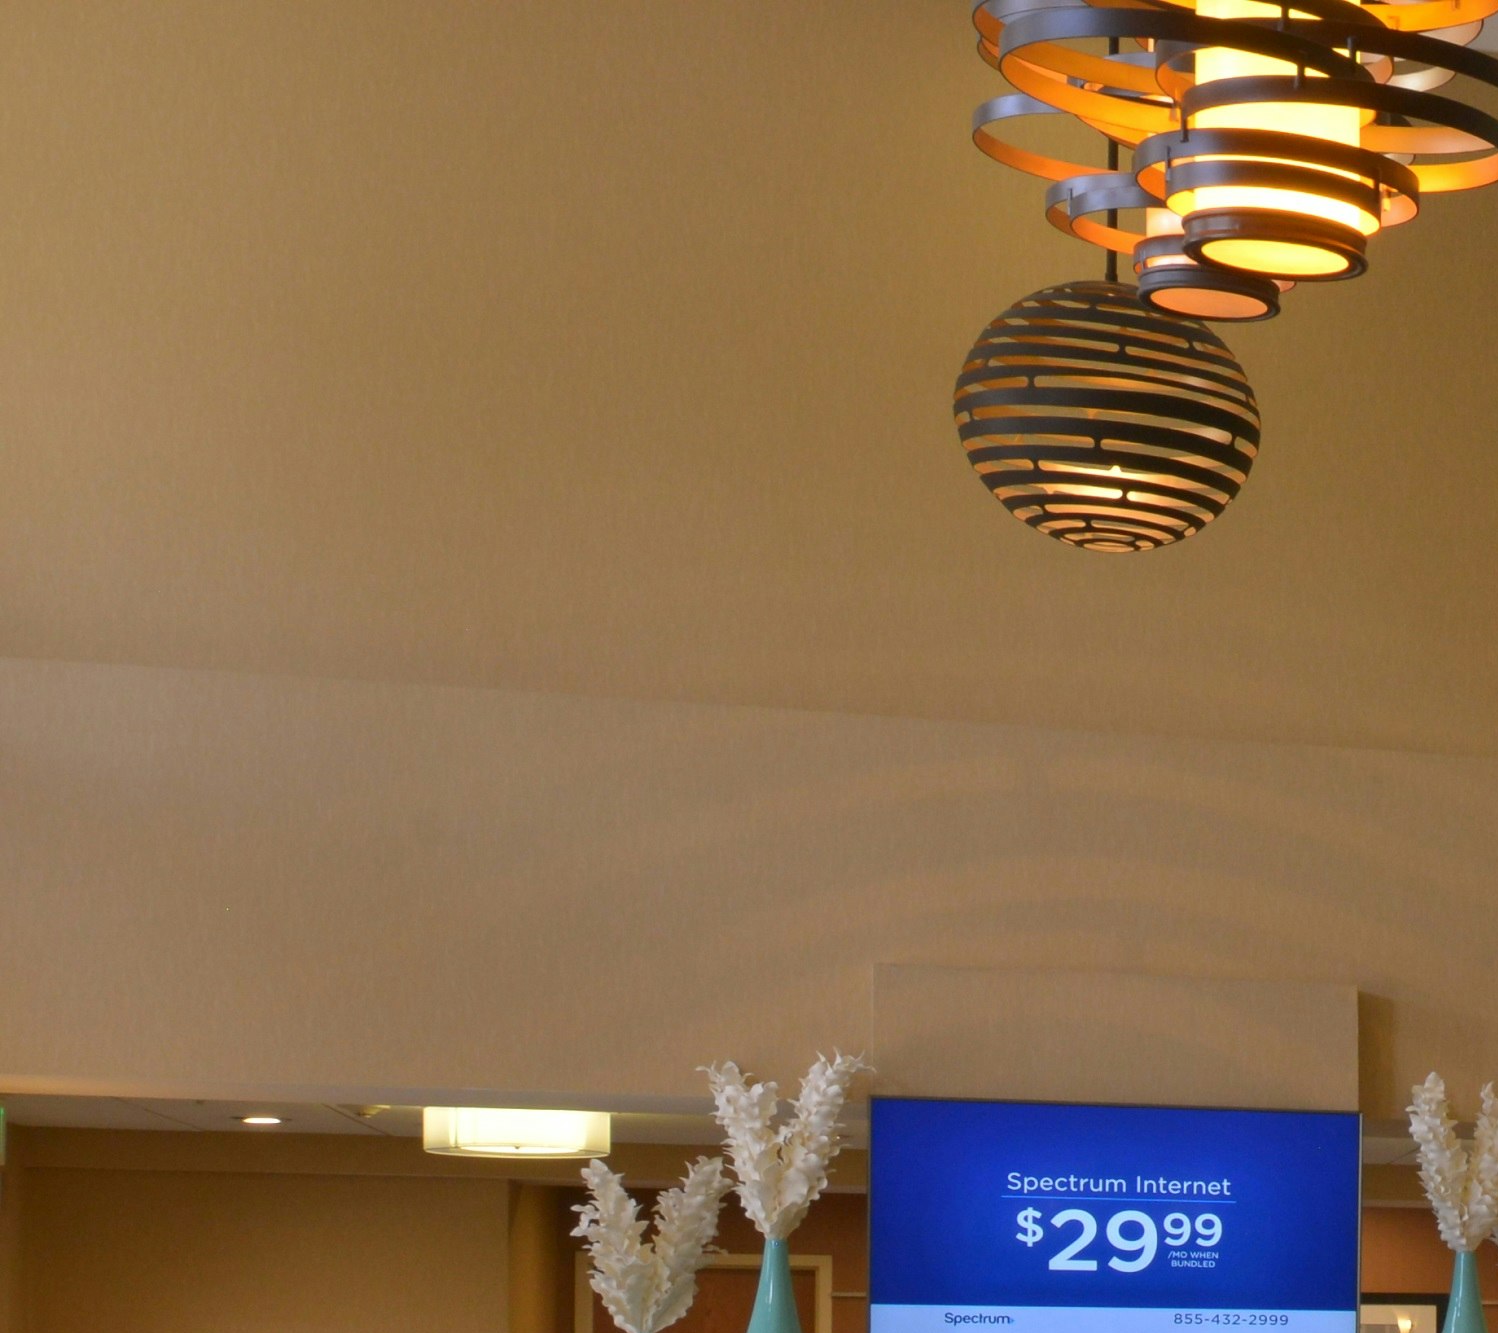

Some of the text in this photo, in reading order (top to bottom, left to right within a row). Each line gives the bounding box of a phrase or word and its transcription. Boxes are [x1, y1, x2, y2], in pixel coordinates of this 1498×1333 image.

[1007, 1172, 1231, 1196] Spectrum Internet
[1190, 1251, 1219, 1260] WHEN
[1171, 1260, 1216, 1268] BUNDLED
[944, 1312, 1289, 1326] Spectrum 855-432-2999
